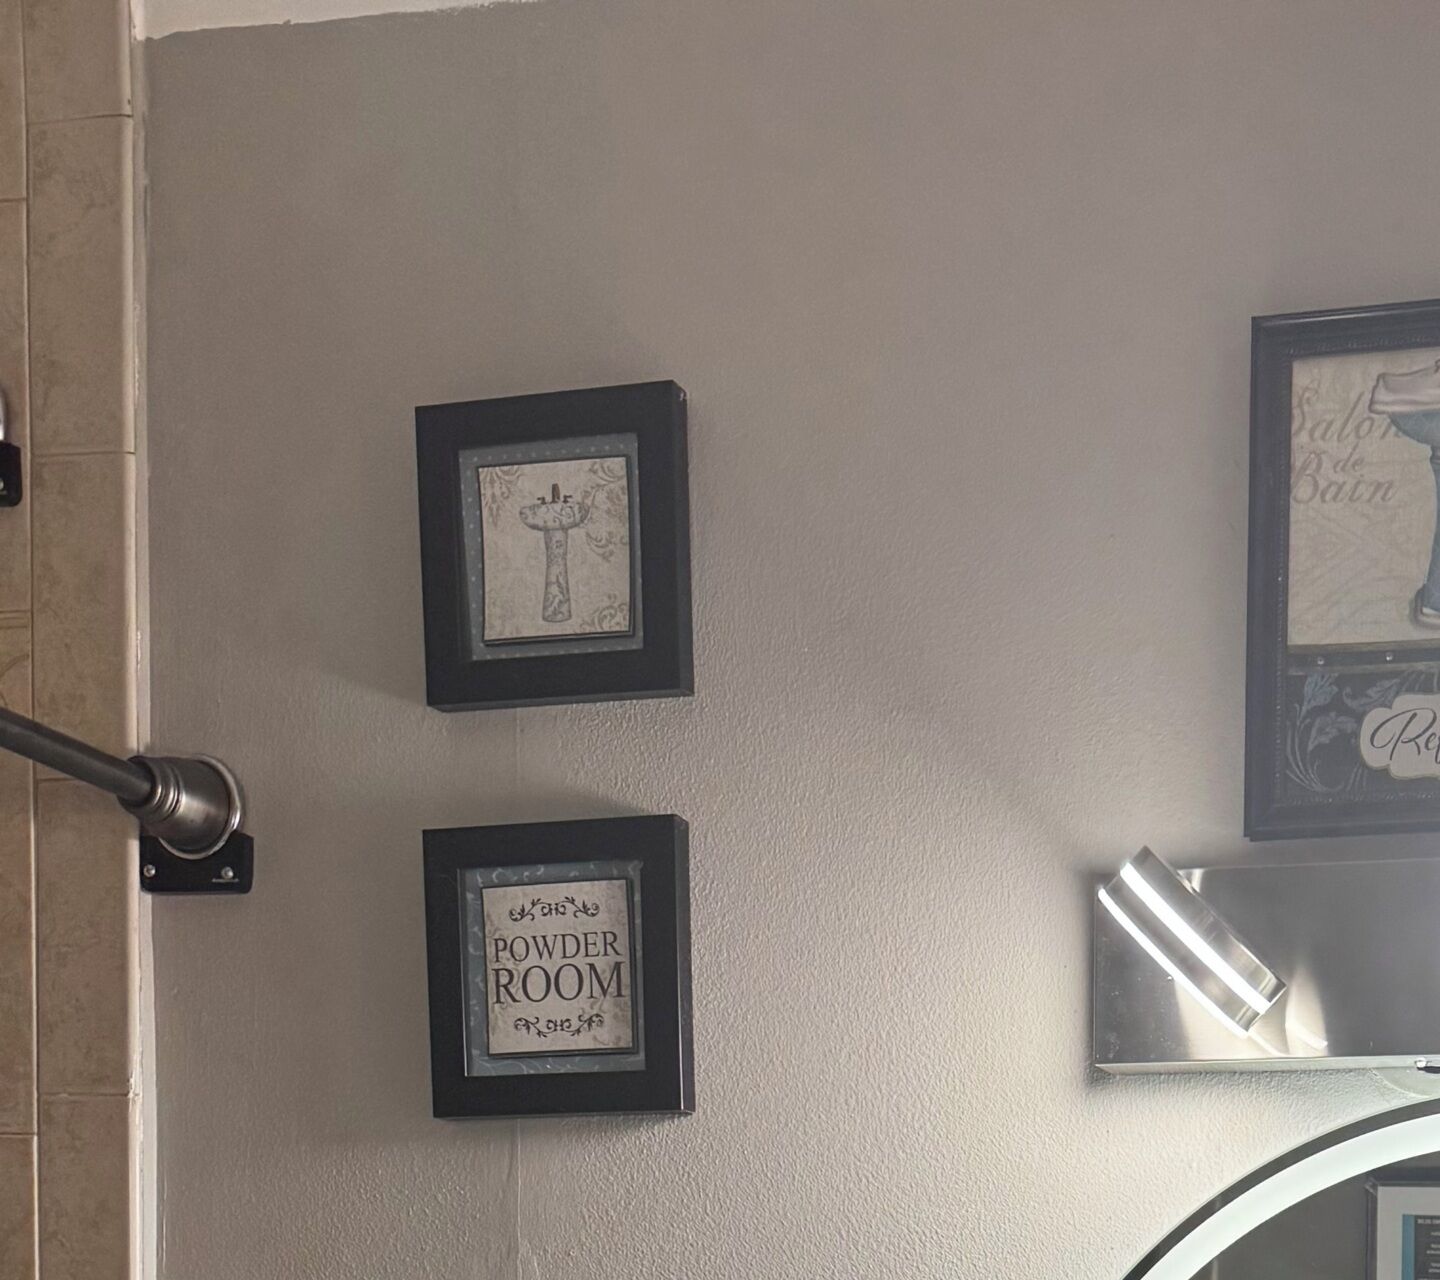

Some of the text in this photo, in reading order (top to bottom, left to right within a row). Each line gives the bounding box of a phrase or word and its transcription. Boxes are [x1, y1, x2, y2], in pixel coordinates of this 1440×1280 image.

[1292, 451, 1398, 504] Bain
[493, 930, 622, 963] POWDER
[491, 961, 625, 1005] ROOM
